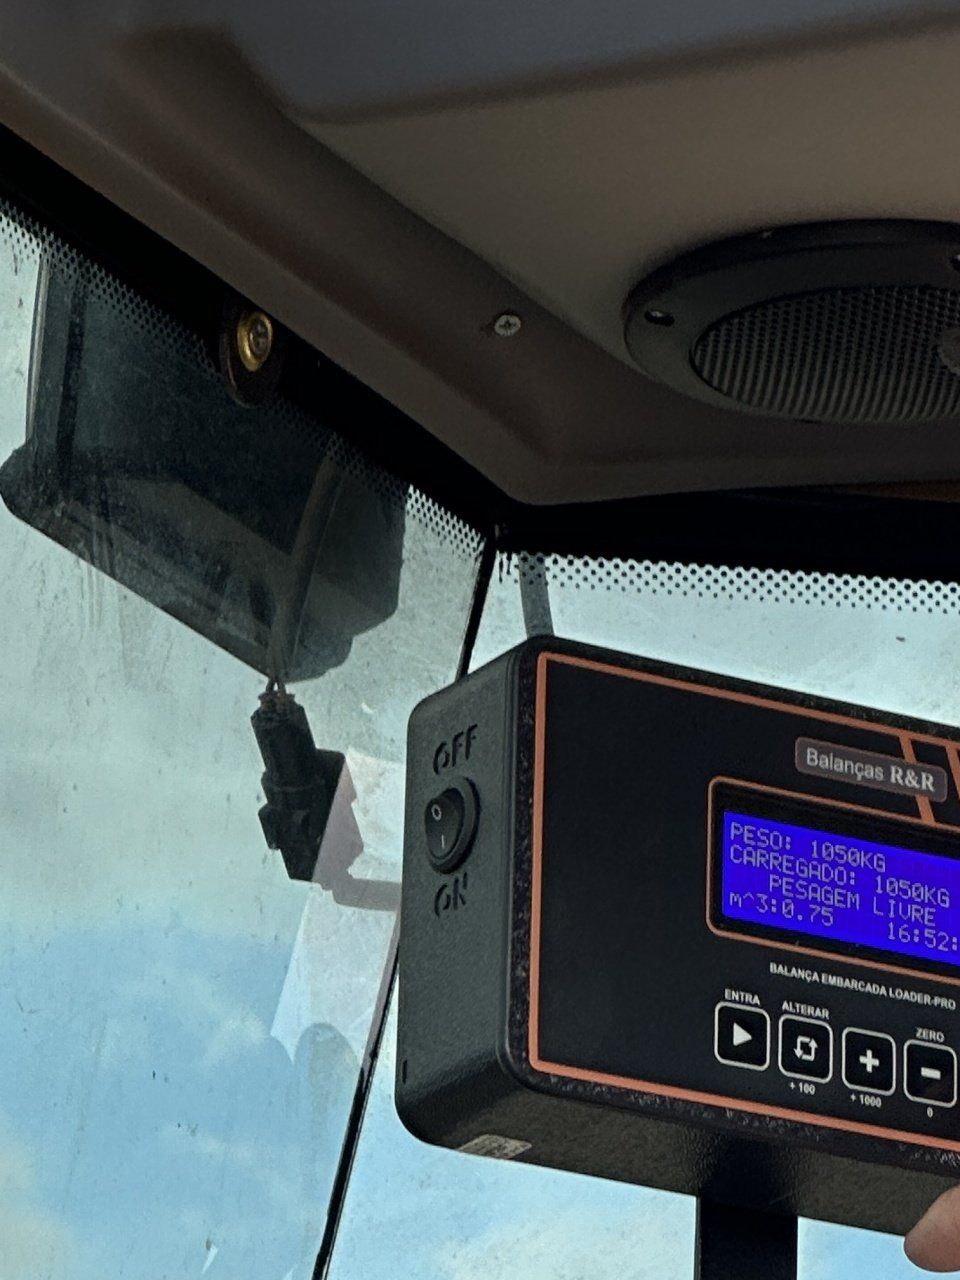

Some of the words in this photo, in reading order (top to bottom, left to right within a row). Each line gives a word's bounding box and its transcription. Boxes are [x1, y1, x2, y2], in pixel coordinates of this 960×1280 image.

[433, 724, 478, 775] OFF
[806, 747, 886, 782] Balanças
[890, 766, 935, 791] R&R
[730, 822, 791, 850] PESO:
[811, 840, 886, 873] 1050KG
[730, 845, 855, 886] CARREGADO:
[875, 875, 950, 908] 1050KG
[769, 875, 860, 910] PESAGEM
[873, 897, 935, 927] LIVRE
[724, 988, 761, 1006] ENTRA
[769, 962, 819, 983] BALANÇA
[821, 973, 887, 996] EMBARCADA
[782, 1001, 830, 1020] ALTERAR
[915, 1027, 945, 1042] ZERO
[927, 1107, 933, 1118] 0
